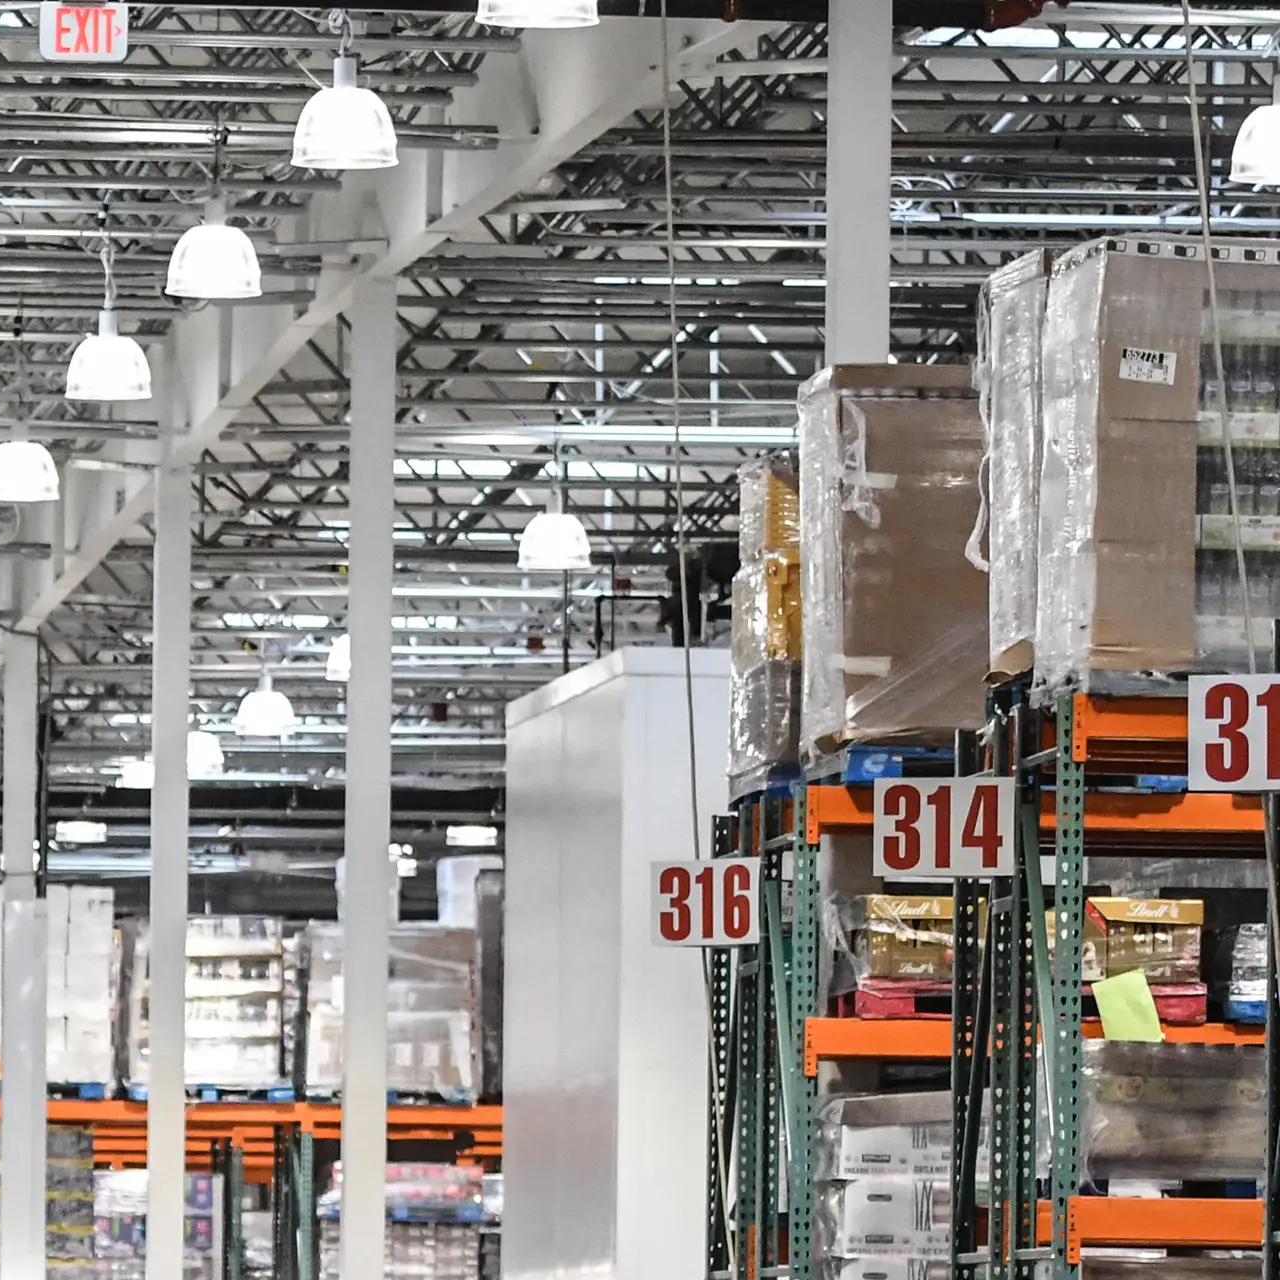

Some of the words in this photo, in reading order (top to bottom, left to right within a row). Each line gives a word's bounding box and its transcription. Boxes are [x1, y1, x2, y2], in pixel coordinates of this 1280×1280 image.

[55, 7, 117, 54] EXIT
[882, 784, 1003, 870] 314
[659, 865, 751, 941] 316
[891, 901, 931, 917] Lindt
[1127, 902, 1167, 918] Lindt
